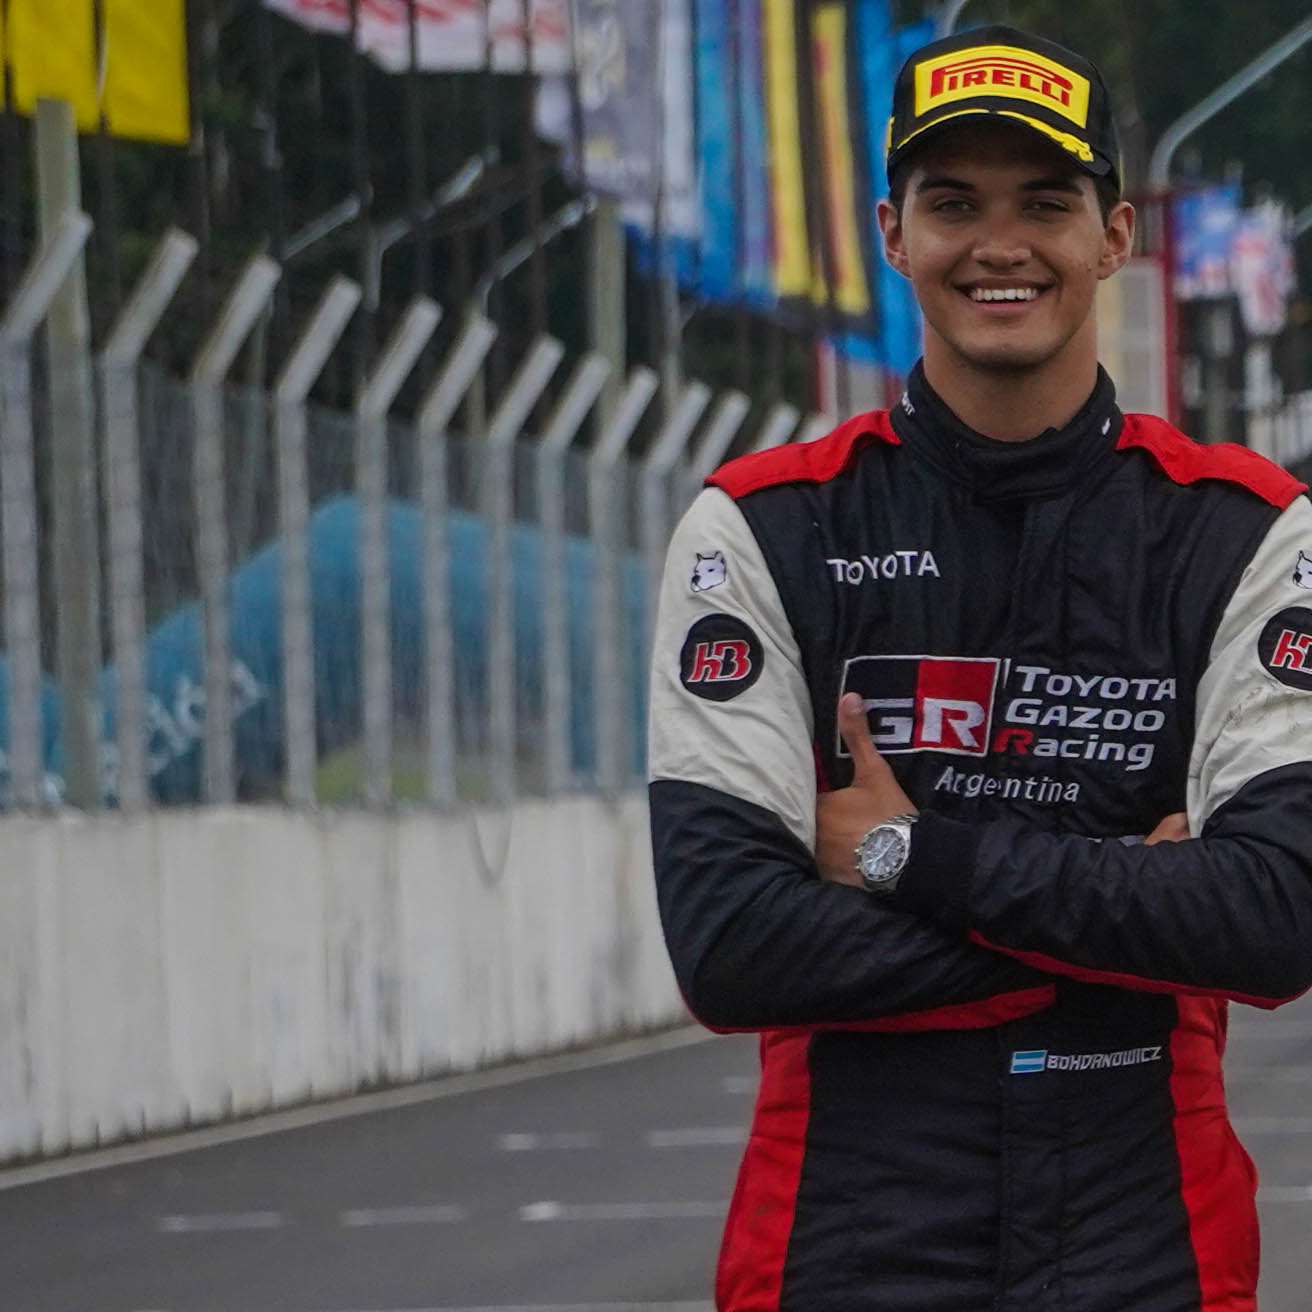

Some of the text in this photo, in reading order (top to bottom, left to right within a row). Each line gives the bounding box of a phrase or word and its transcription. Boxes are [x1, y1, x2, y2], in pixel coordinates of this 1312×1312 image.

[930, 56, 1074, 108] PIRELLI
[826, 550, 941, 586] TOYOTA
[857, 697, 986, 748] GR
[1005, 698, 1166, 732] GAZOO
[992, 728, 1155, 772] Racing
[934, 765, 1081, 803] Argentina
[1046, 1046, 1162, 1071] BOHDANOWICZ
